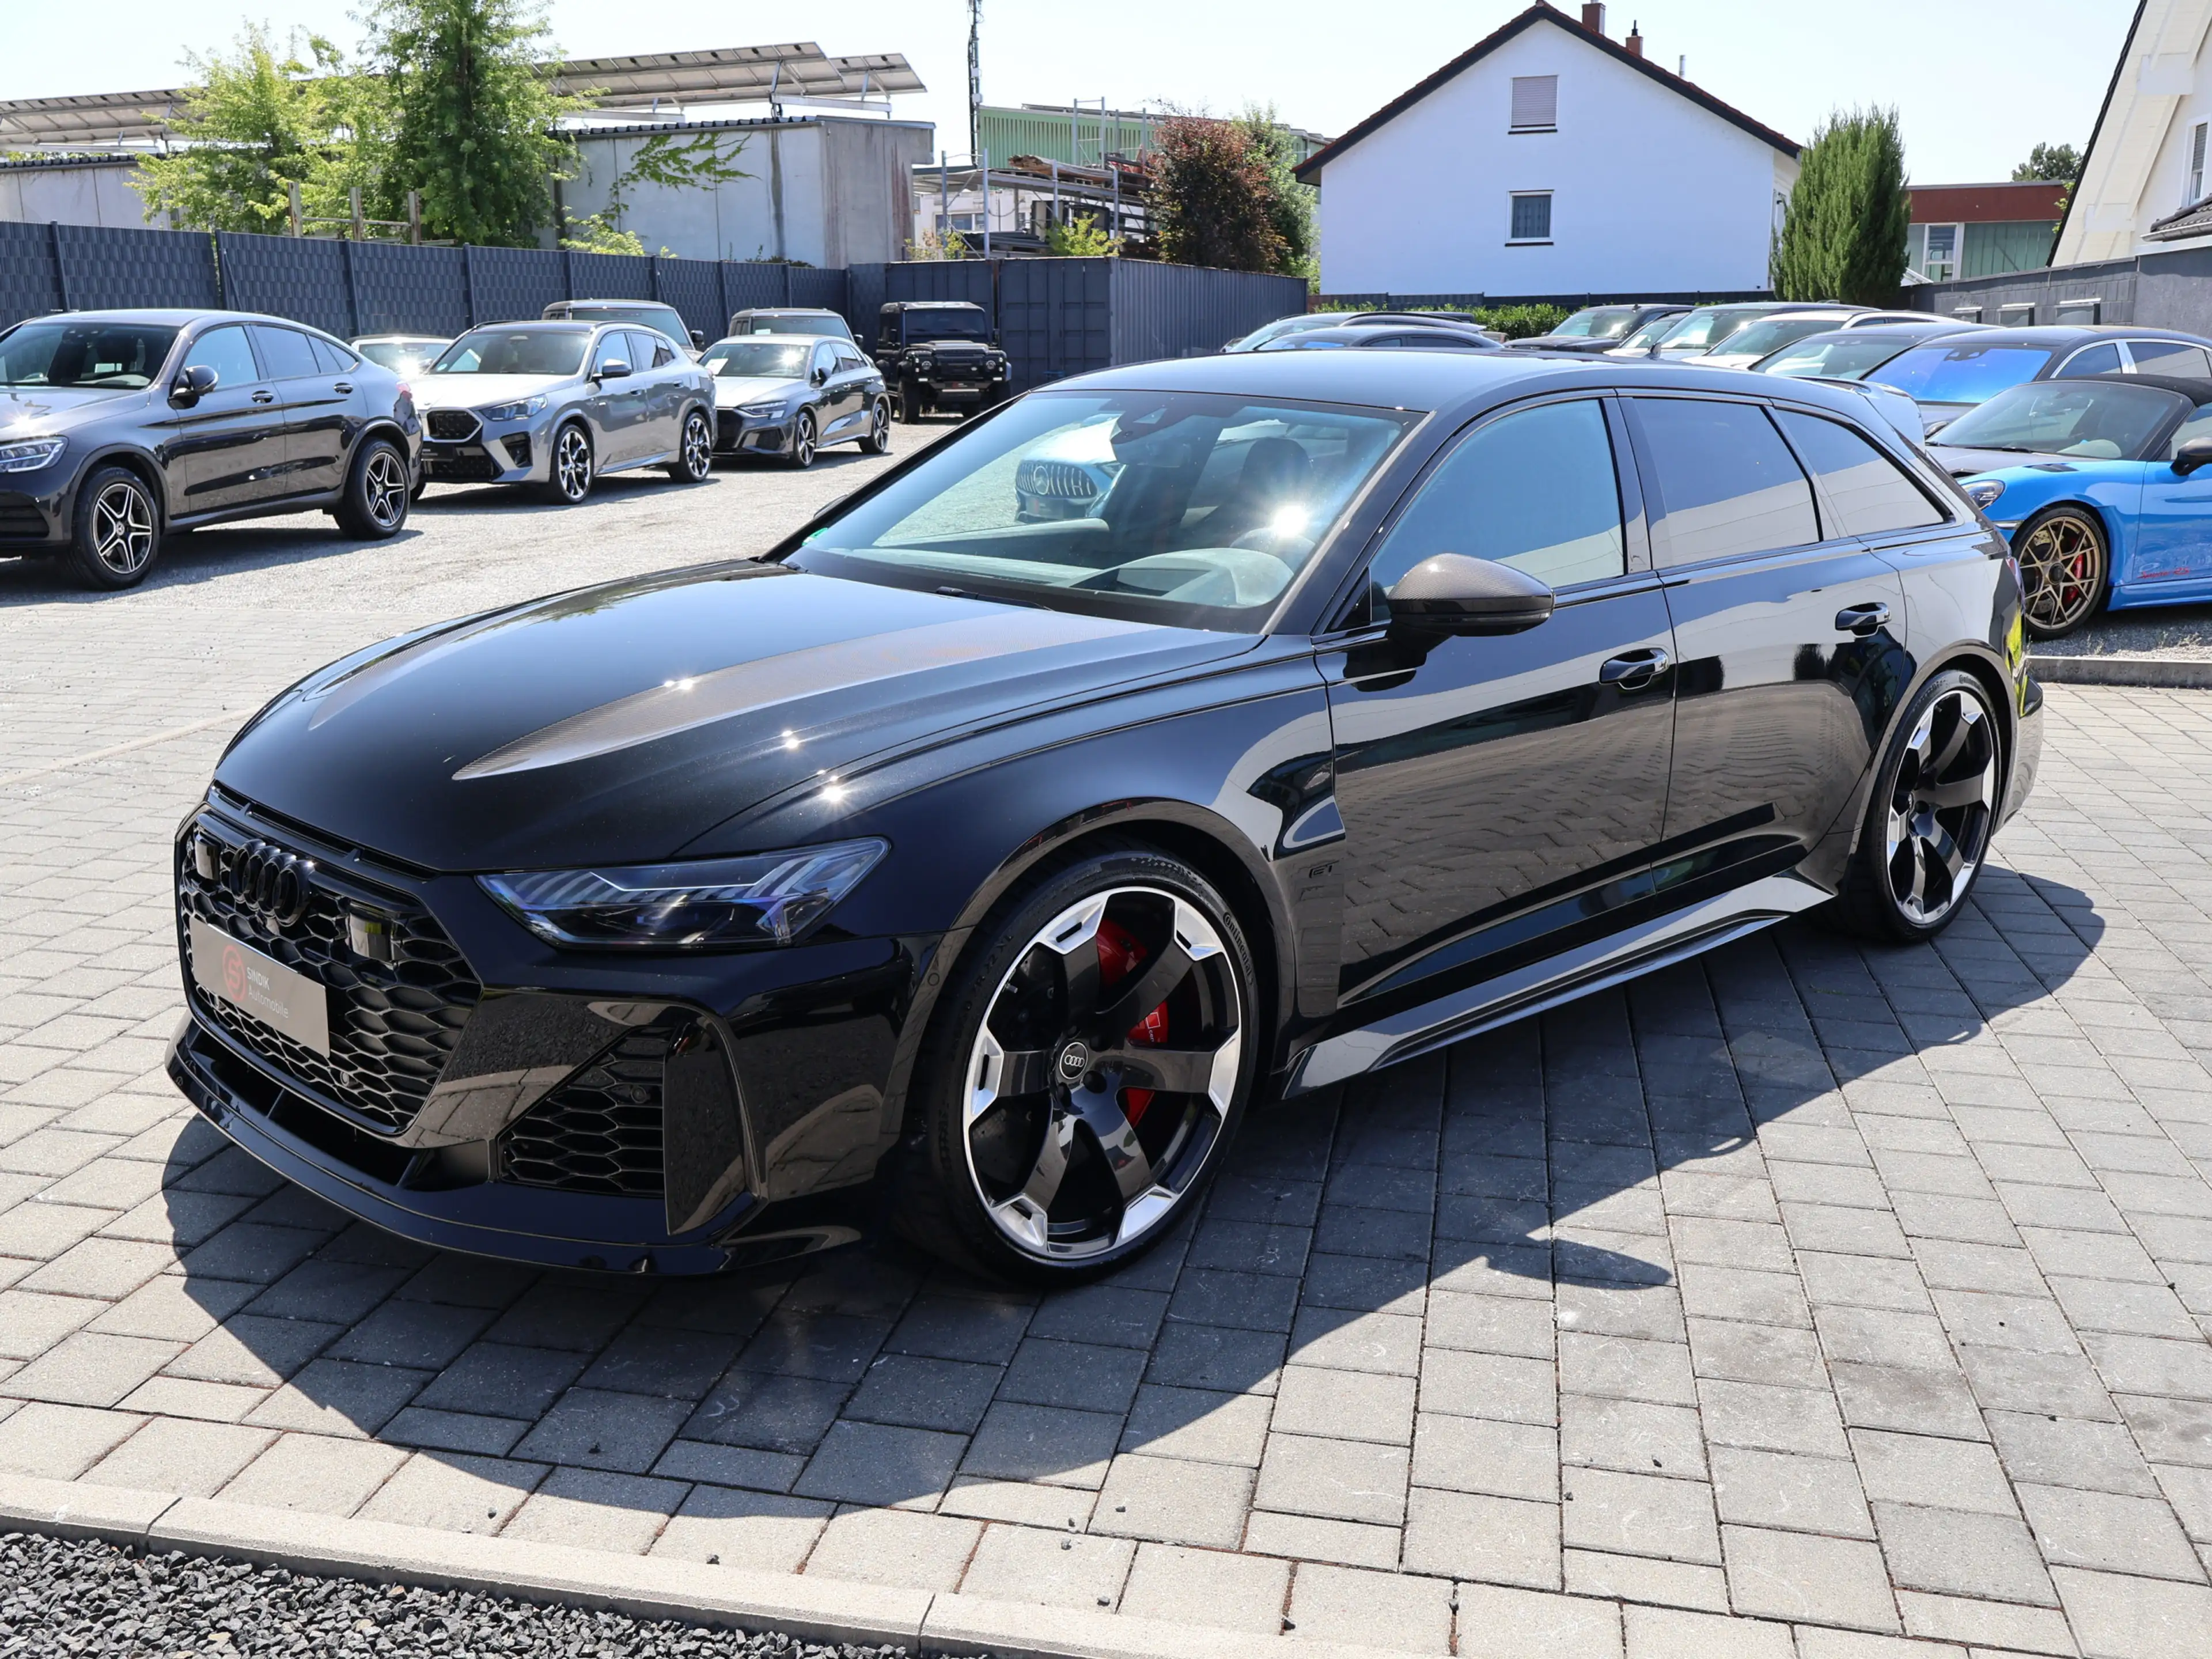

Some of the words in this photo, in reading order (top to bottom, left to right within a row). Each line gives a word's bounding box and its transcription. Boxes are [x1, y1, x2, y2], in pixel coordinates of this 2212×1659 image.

[1222, 912, 1252, 976] Continental
[247, 967, 270, 990] SINDIK
[248, 983, 289, 1018] Automobile
